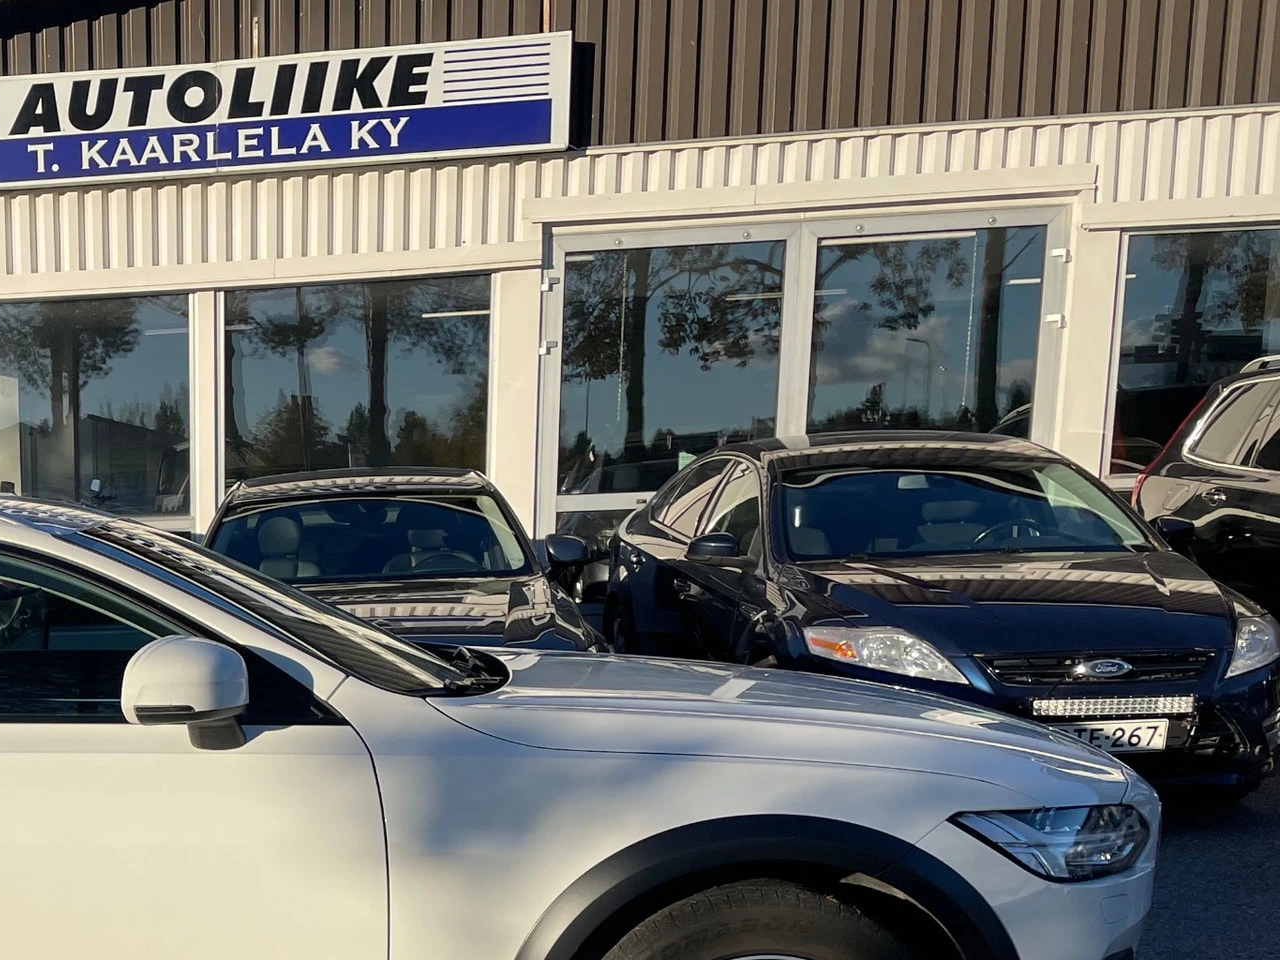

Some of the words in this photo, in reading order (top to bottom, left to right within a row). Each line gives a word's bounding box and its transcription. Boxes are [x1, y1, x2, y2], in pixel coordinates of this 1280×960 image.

[8, 52, 435, 136] AUTOLIIKE
[27, 142, 60, 173] T.
[80, 123, 331, 169] KAARLELA
[350, 116, 410, 150] KY
[1095, 662, 1119, 672] Ford
[1061, 726, 1160, 749] TE-267
